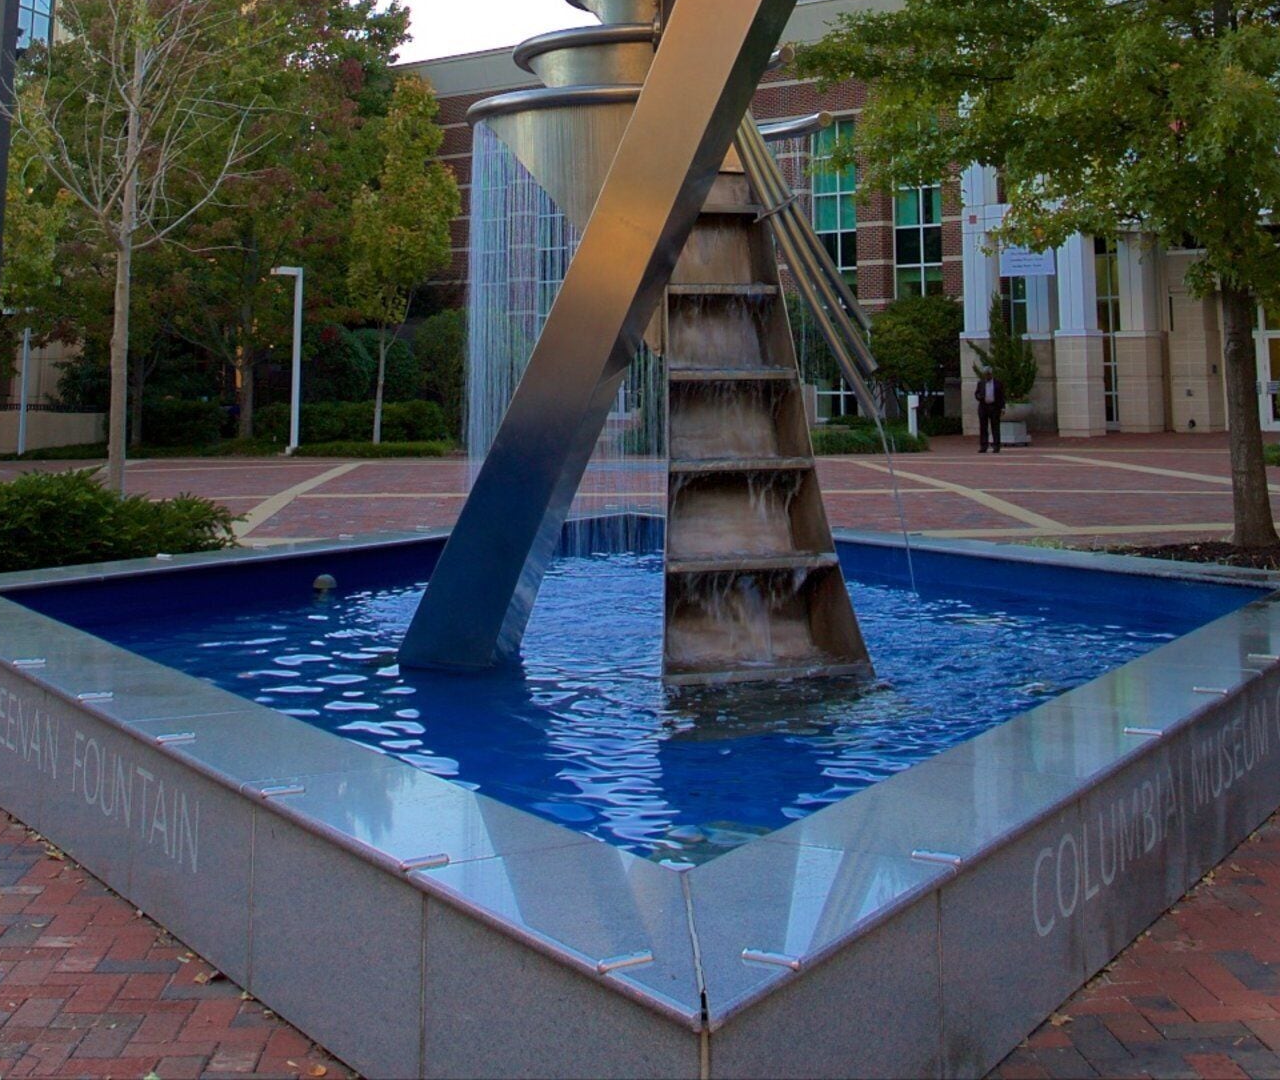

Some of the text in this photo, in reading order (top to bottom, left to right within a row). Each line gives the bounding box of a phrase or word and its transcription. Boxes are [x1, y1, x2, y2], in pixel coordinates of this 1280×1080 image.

[72, 730, 200, 873] FOUNTAIN
[1033, 770, 1179, 936] COLUMBIA
[1191, 699, 1270, 814] MUSEUM
